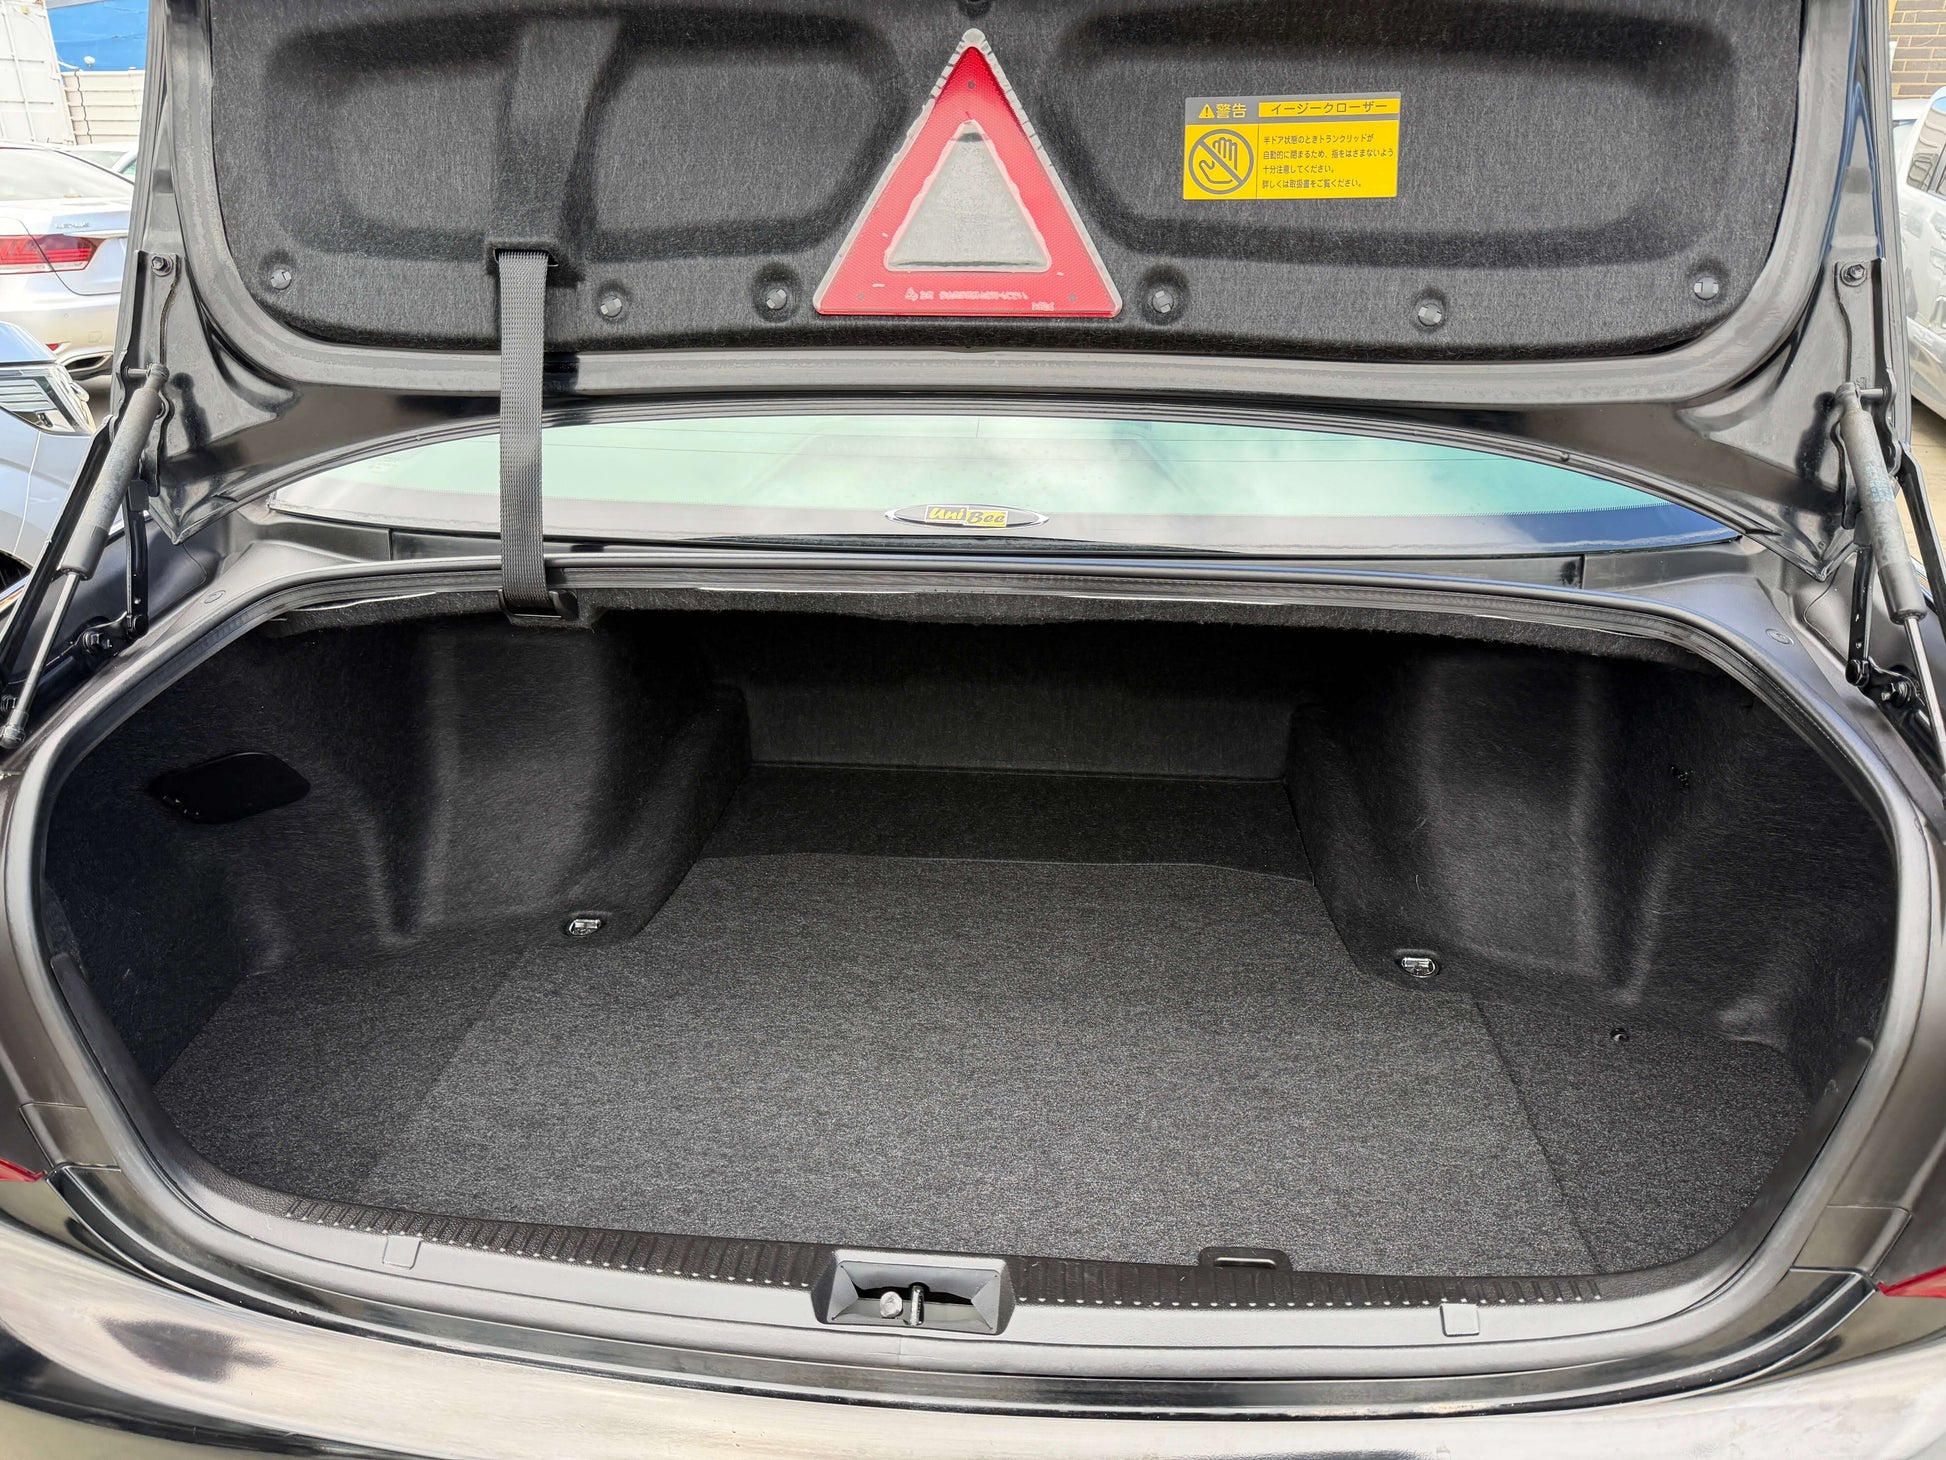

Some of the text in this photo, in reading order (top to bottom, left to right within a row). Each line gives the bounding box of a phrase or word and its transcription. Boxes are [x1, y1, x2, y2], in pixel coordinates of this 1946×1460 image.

[1216, 101, 1388, 118] 警告 イージークローザー
